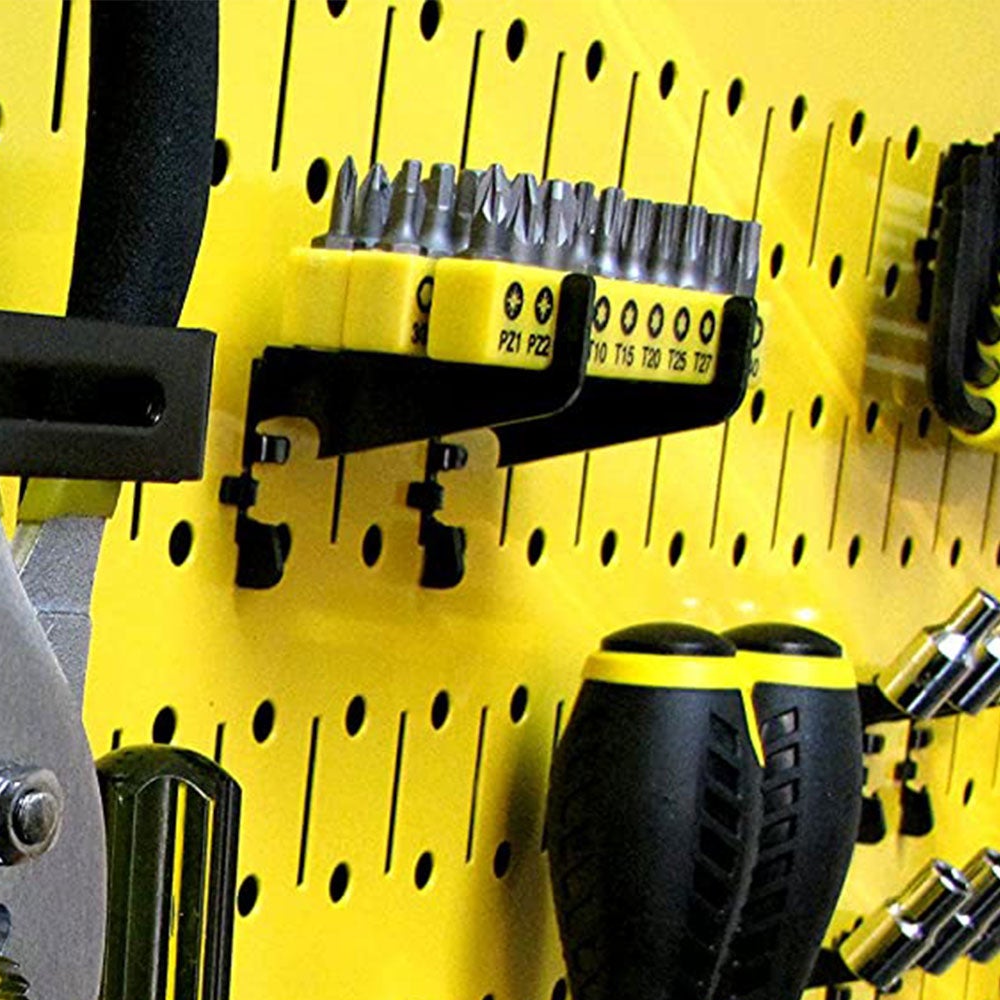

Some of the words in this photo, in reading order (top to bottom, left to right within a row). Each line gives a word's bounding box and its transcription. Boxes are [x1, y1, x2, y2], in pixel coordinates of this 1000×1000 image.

[498, 329, 521, 354] PZ1
[526, 333, 551, 356] PZ2
[614, 342, 635, 367] T15
[641, 345, 661, 370] T20
[668, 348, 687, 372] T25
[693, 351, 712, 374] T27
